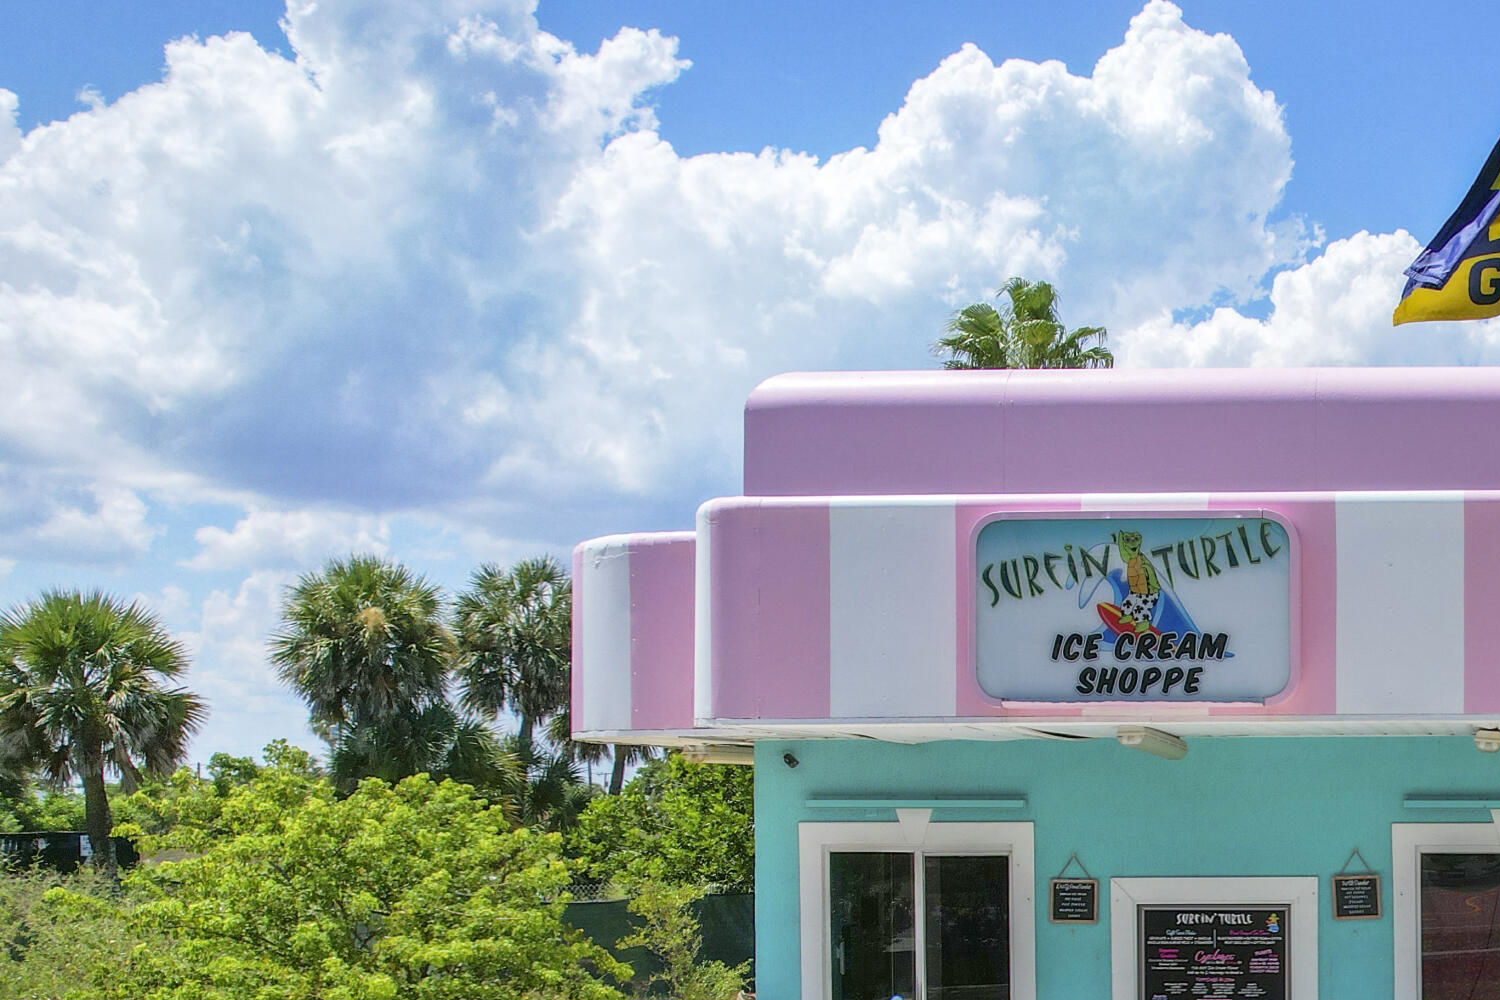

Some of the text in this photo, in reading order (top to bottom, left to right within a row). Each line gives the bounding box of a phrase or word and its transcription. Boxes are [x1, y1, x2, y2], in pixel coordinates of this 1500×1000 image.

[1151, 521, 1281, 589] TURTLE
[1051, 631, 1229, 662] ICE CREAM
[1075, 665, 1204, 696] SHOPPE
[1219, 912, 1254, 925] TURTLE
